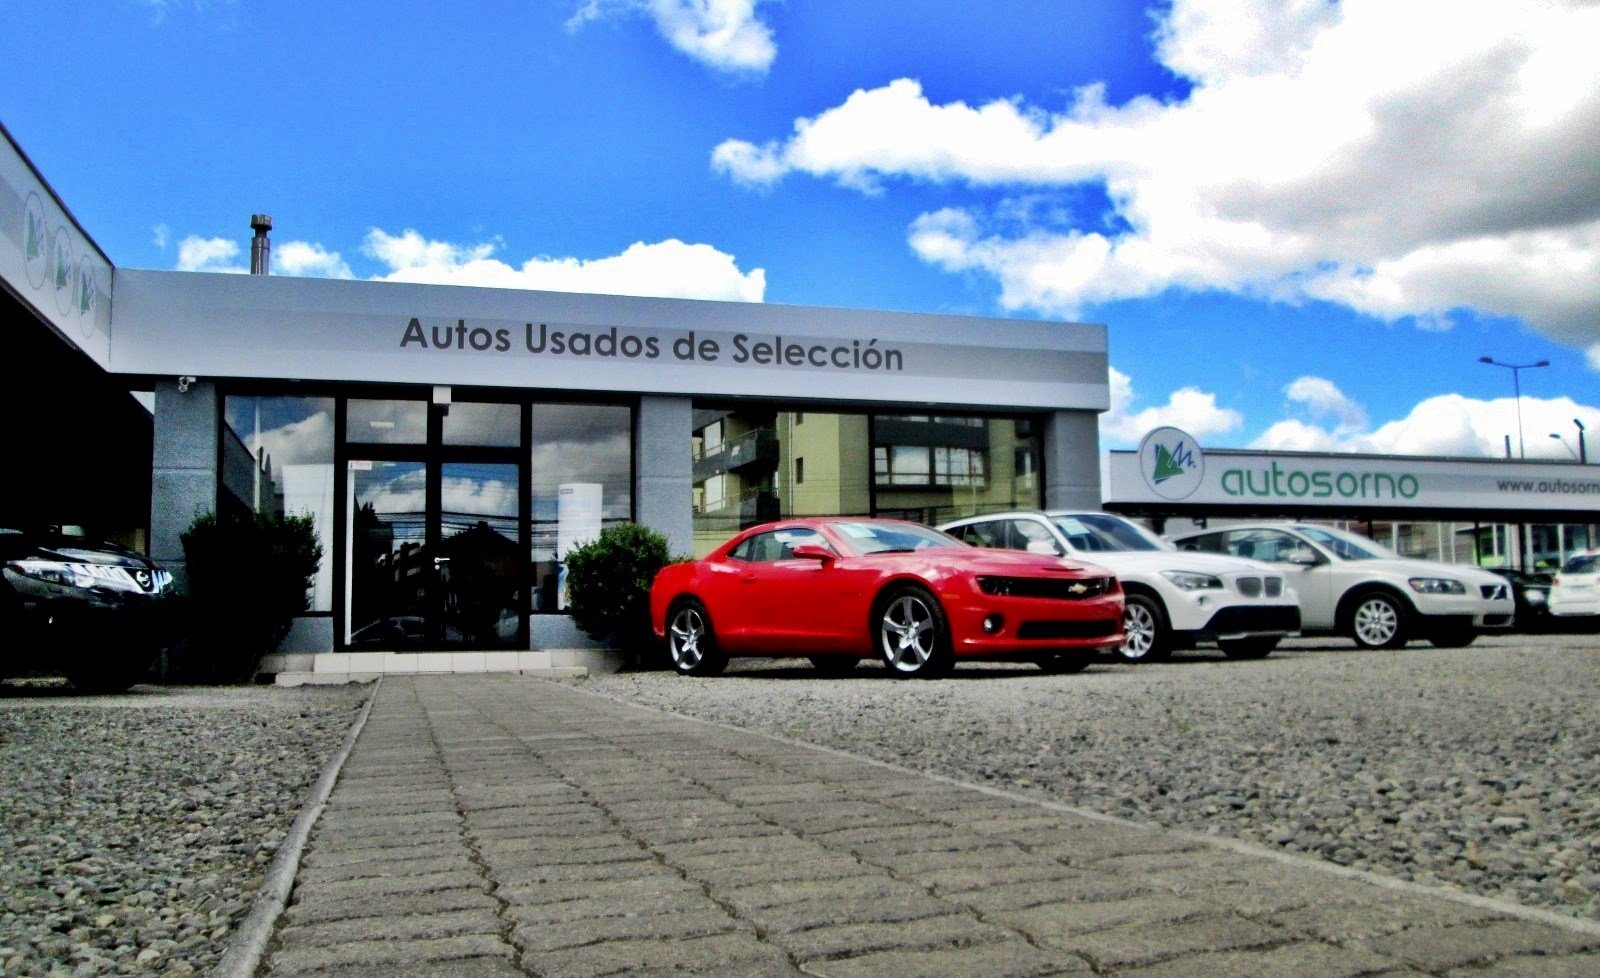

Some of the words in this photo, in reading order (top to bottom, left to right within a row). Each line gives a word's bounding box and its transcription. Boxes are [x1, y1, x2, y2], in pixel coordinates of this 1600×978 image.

[399, 317, 511, 352] Autos
[525, 323, 661, 359] Usados
[672, 330, 720, 362] de
[732, 333, 903, 370] Selección
[1220, 460, 1421, 499] autosorno
